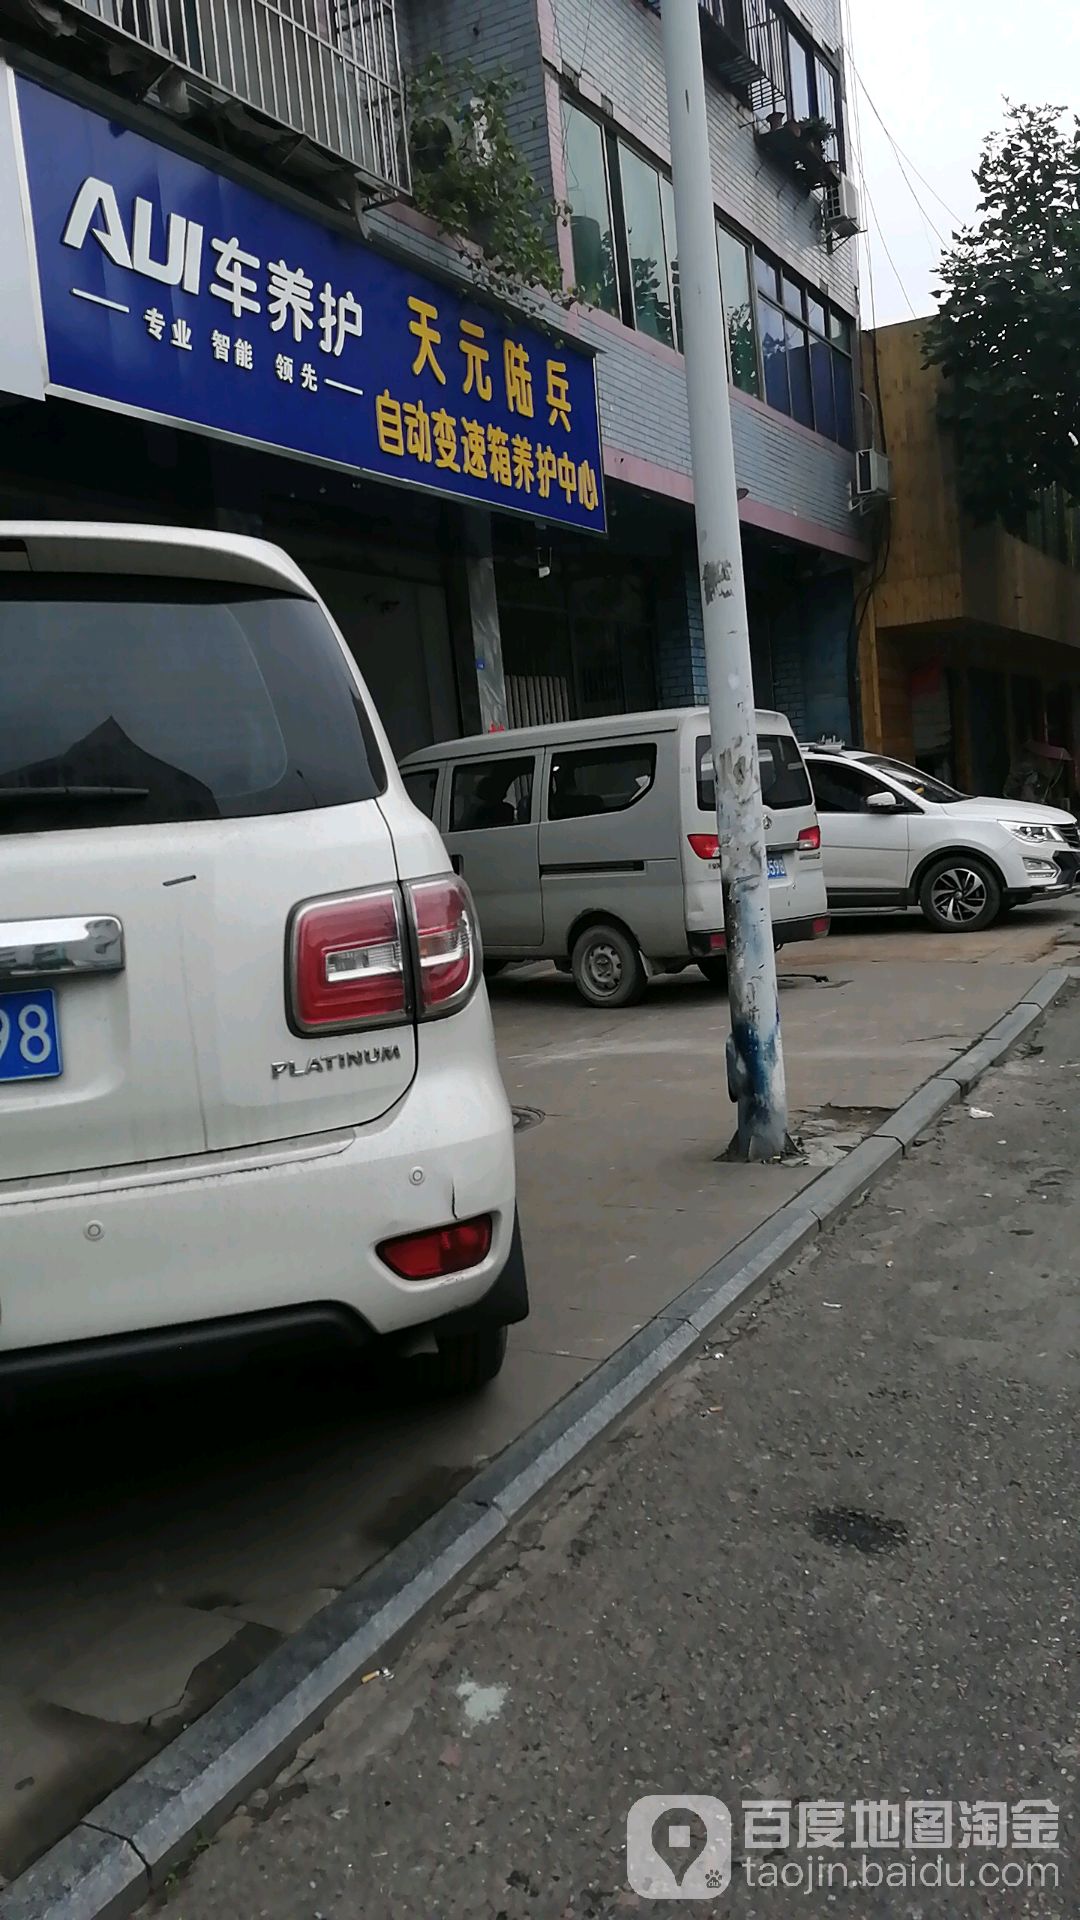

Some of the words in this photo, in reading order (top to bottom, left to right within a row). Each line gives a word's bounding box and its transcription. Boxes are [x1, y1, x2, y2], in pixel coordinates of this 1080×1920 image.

[144, 307, 193, 350] 专业
[211, 329, 254, 370] 智能
[275, 353, 318, 392] 领先
[407, 296, 572, 432] 天元陆兵
[375, 389, 599, 511] 自动变速箱养护中心
[271, 1045, 401, 1080] PLATINUM
